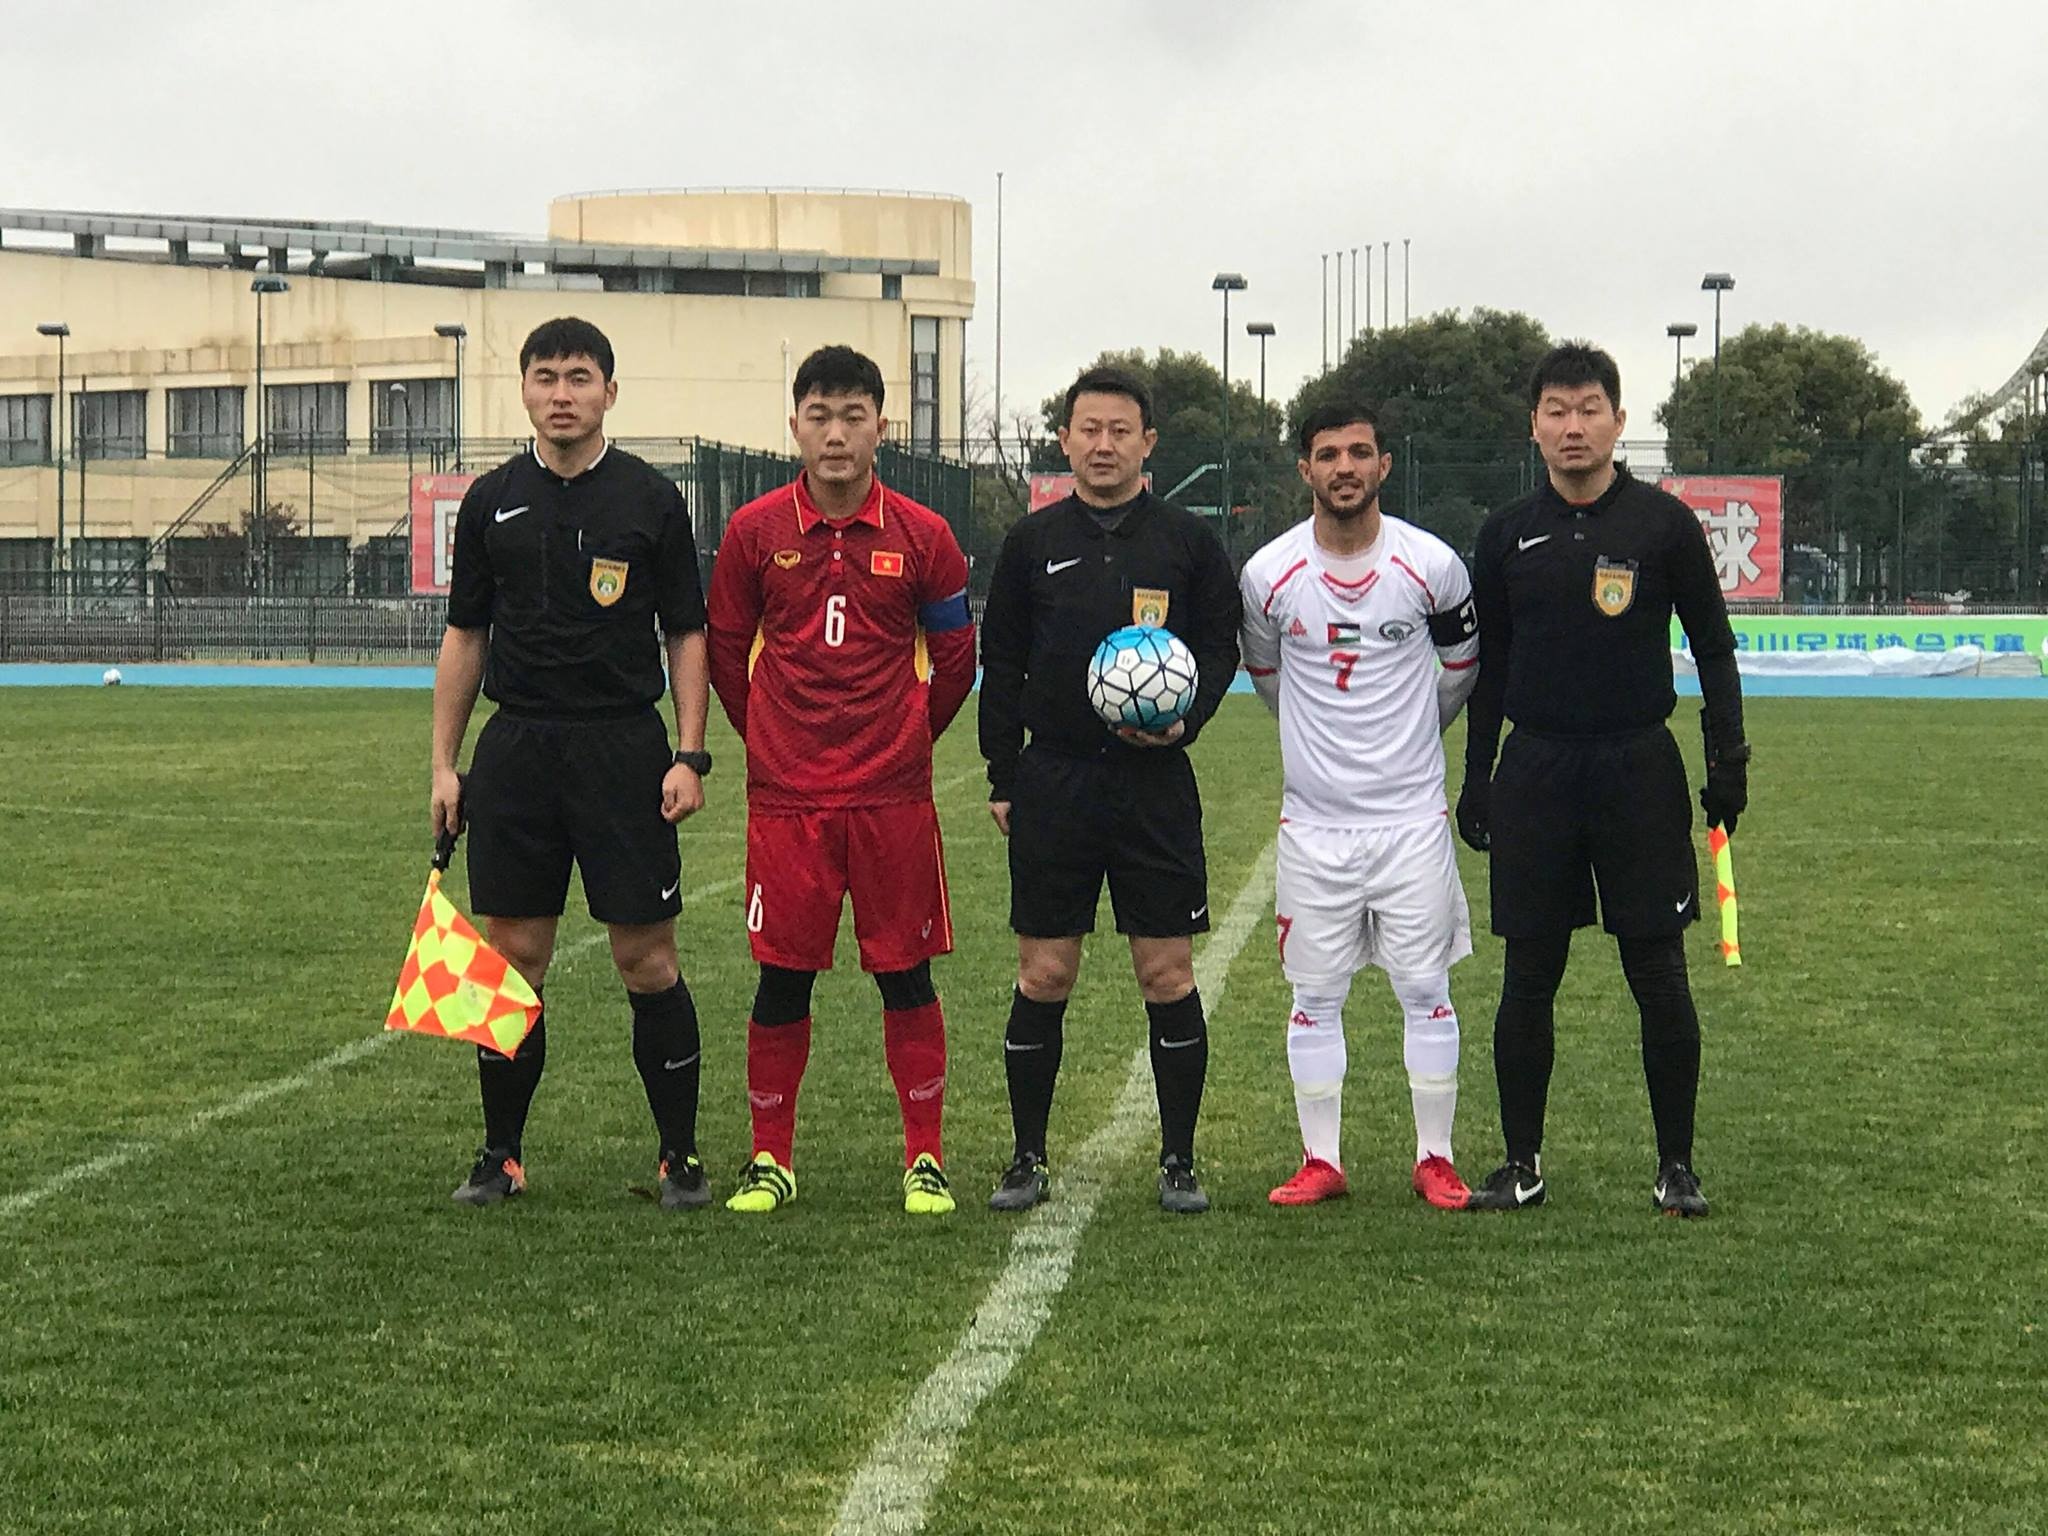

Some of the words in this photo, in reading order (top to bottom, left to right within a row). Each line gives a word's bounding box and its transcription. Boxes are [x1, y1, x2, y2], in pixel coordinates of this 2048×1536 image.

[1698, 500, 1762, 592] 球
[824, 594, 847, 648] 6
[1329, 651, 1361, 693] 7
[747, 882, 764, 933] 6
[1276, 912, 1293, 963] 7
